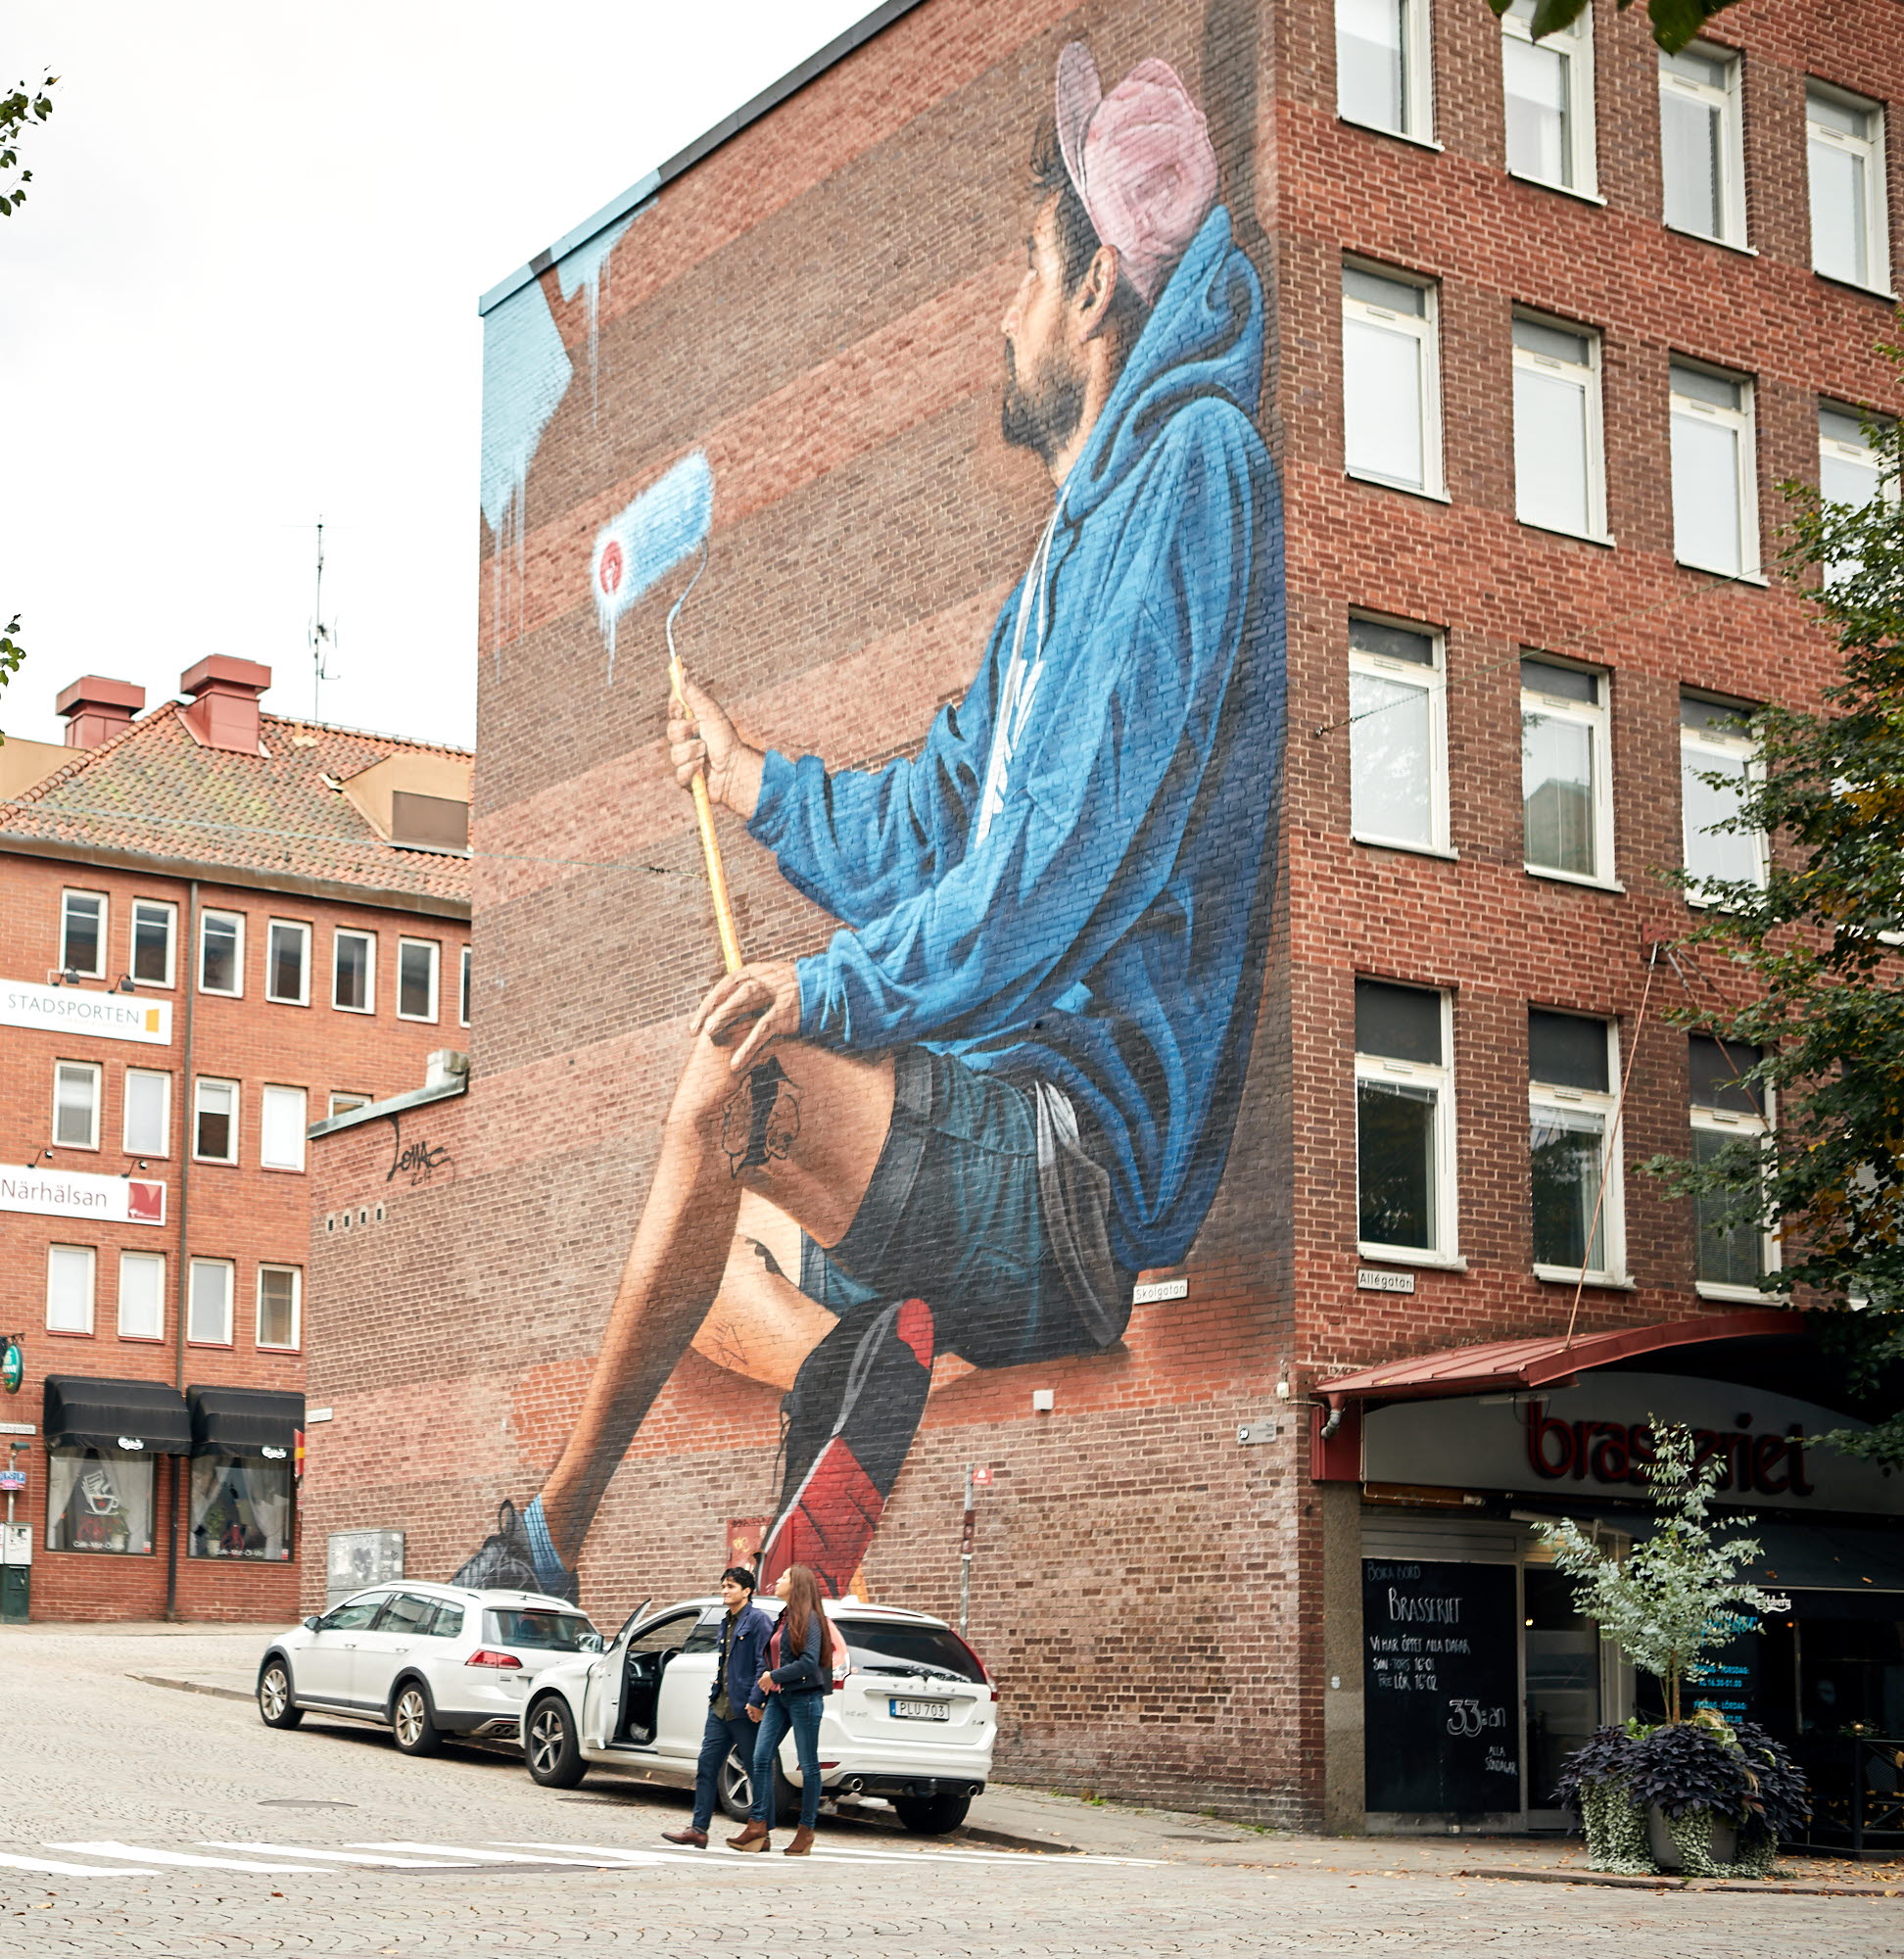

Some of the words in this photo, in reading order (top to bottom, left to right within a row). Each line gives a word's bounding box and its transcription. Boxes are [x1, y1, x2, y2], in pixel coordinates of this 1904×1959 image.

[8, 993, 139, 1024] STADSPORTEN
[1, 1178, 108, 1207] Närhälsan
[1359, 1272, 1412, 1289] Allégatan
[1136, 1284, 1185, 1300] Skolgatan
[1527, 1401, 1814, 1496] braseriet
[1389, 1587, 1463, 1624] BRASSERIET
[1381, 1637, 1400, 1652] HAR
[1402, 1633, 1423, 1652] ÖPPET
[1426, 1639, 1444, 1652] ALLA
[893, 1684, 956, 1694] VOLVO
[900, 1702, 921, 1716] PLU
[925, 1703, 945, 1717] 703
